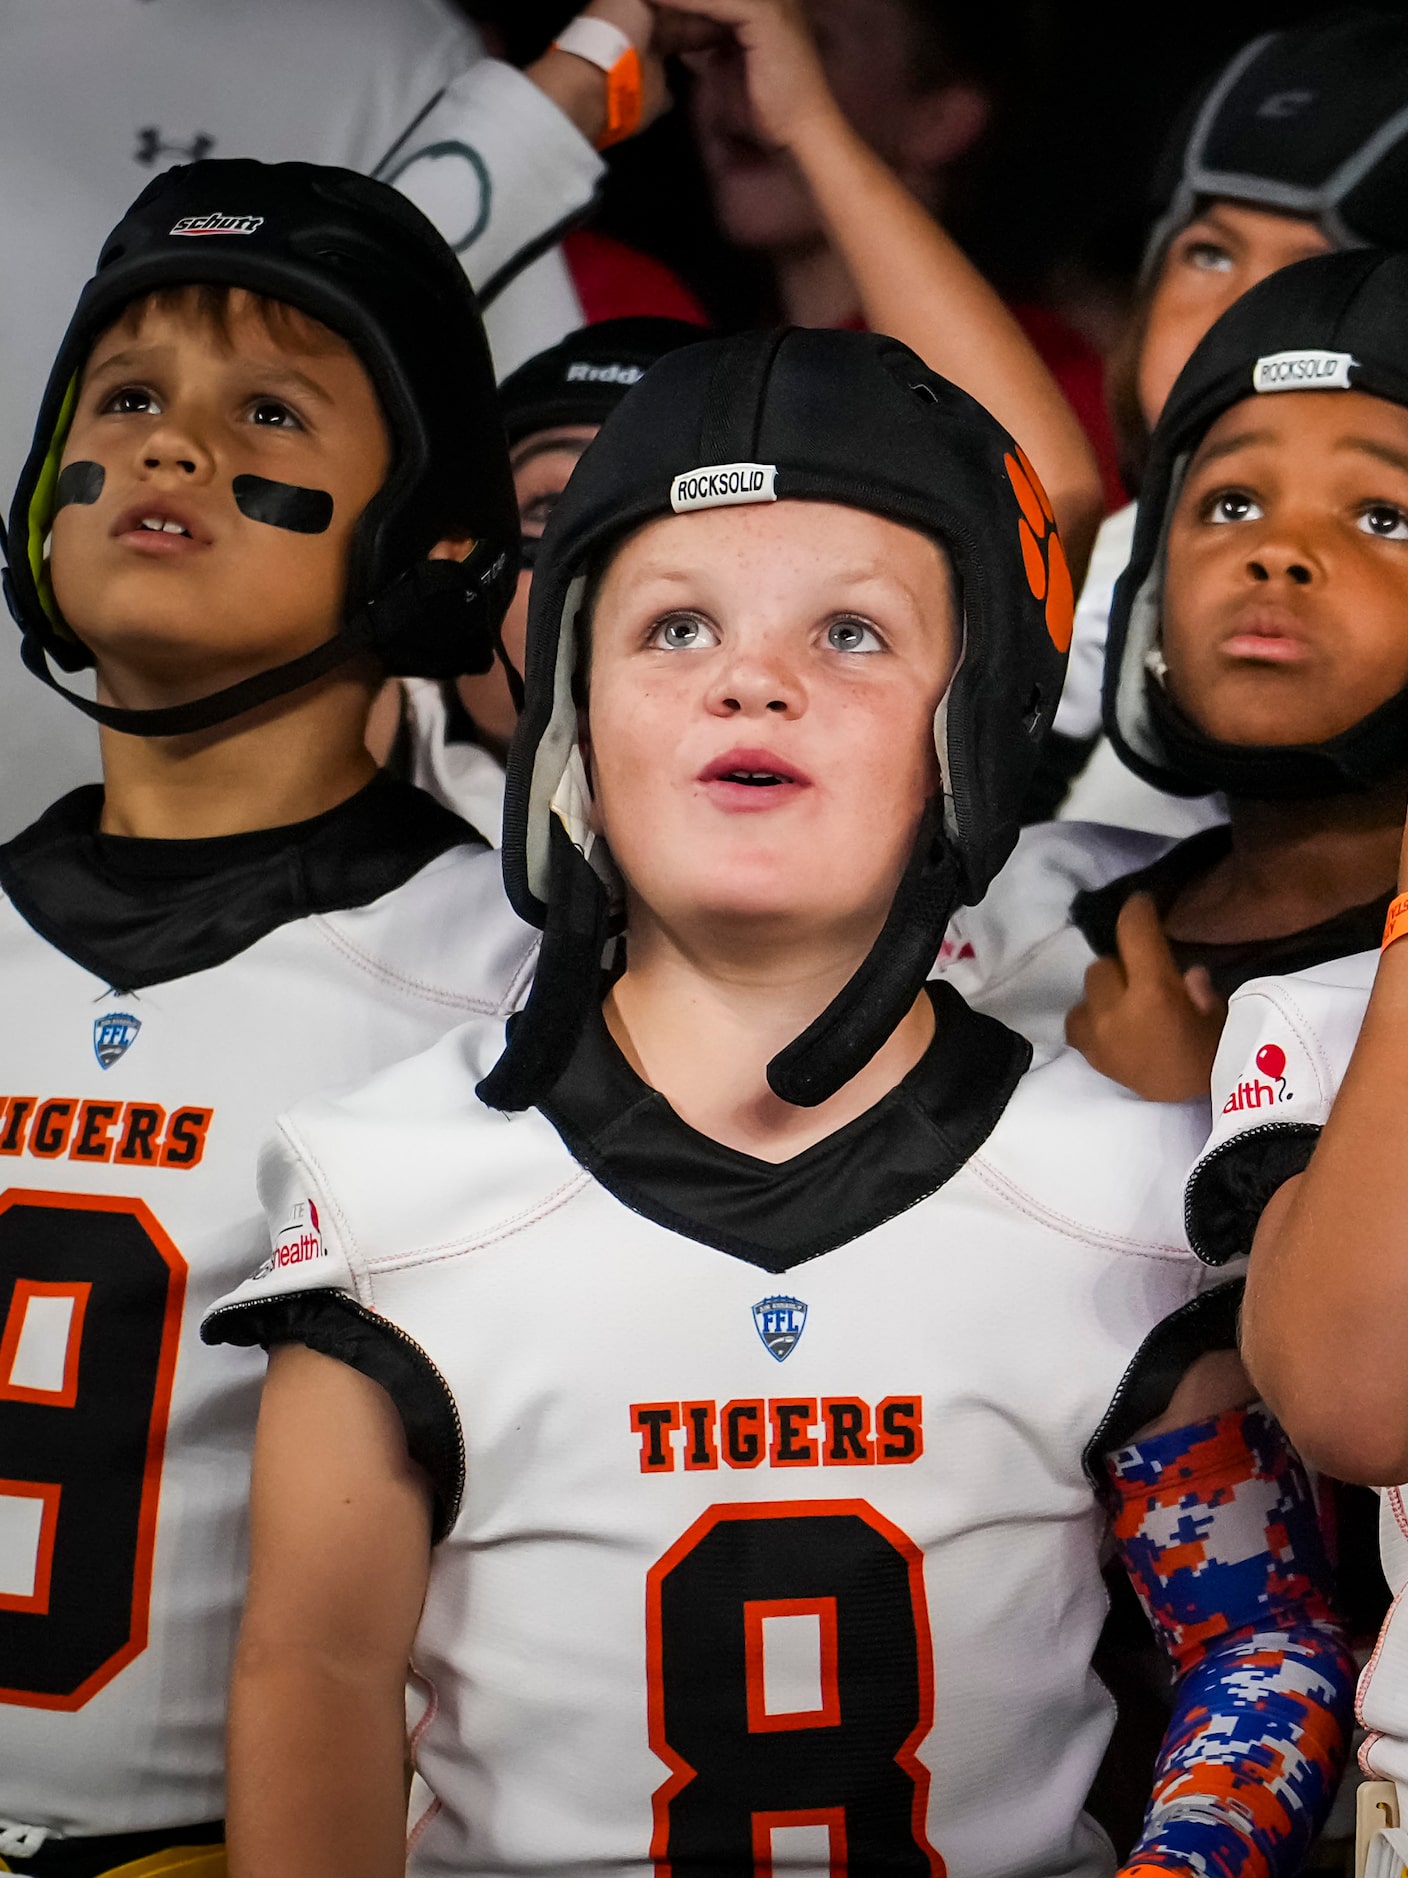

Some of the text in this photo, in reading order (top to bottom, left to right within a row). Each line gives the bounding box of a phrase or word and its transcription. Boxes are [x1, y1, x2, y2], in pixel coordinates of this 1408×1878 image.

[1261, 359, 1338, 384] ROCKSOLID
[678, 471, 765, 501] ROCKSOLID
[97, 1024, 129, 1046] FFL
[762, 1309, 799, 1333] FFL
[629, 1395, 924, 1474] TIGERS
[645, 1498, 948, 1878] 8
